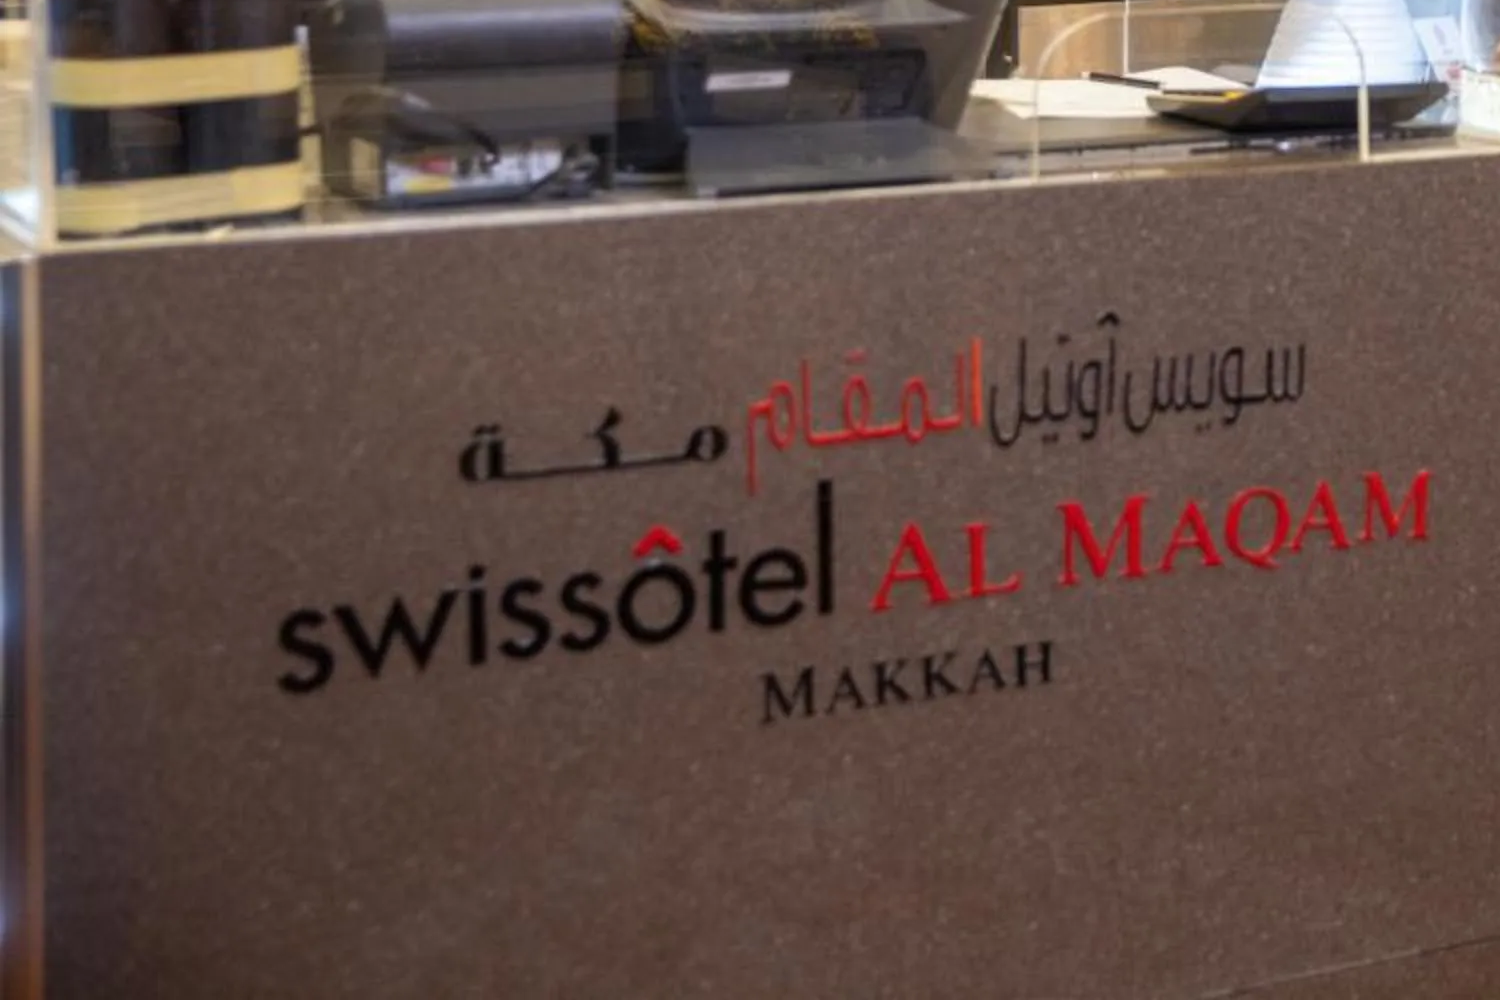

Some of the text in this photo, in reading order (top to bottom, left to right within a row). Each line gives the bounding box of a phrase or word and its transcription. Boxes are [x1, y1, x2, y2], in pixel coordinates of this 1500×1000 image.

[458, 405, 729, 483] مكة
[745, 336, 985, 496] المقام
[276, 468, 1433, 696] swissôtel AL MAQAM
[758, 640, 1055, 724] MAKKAH
